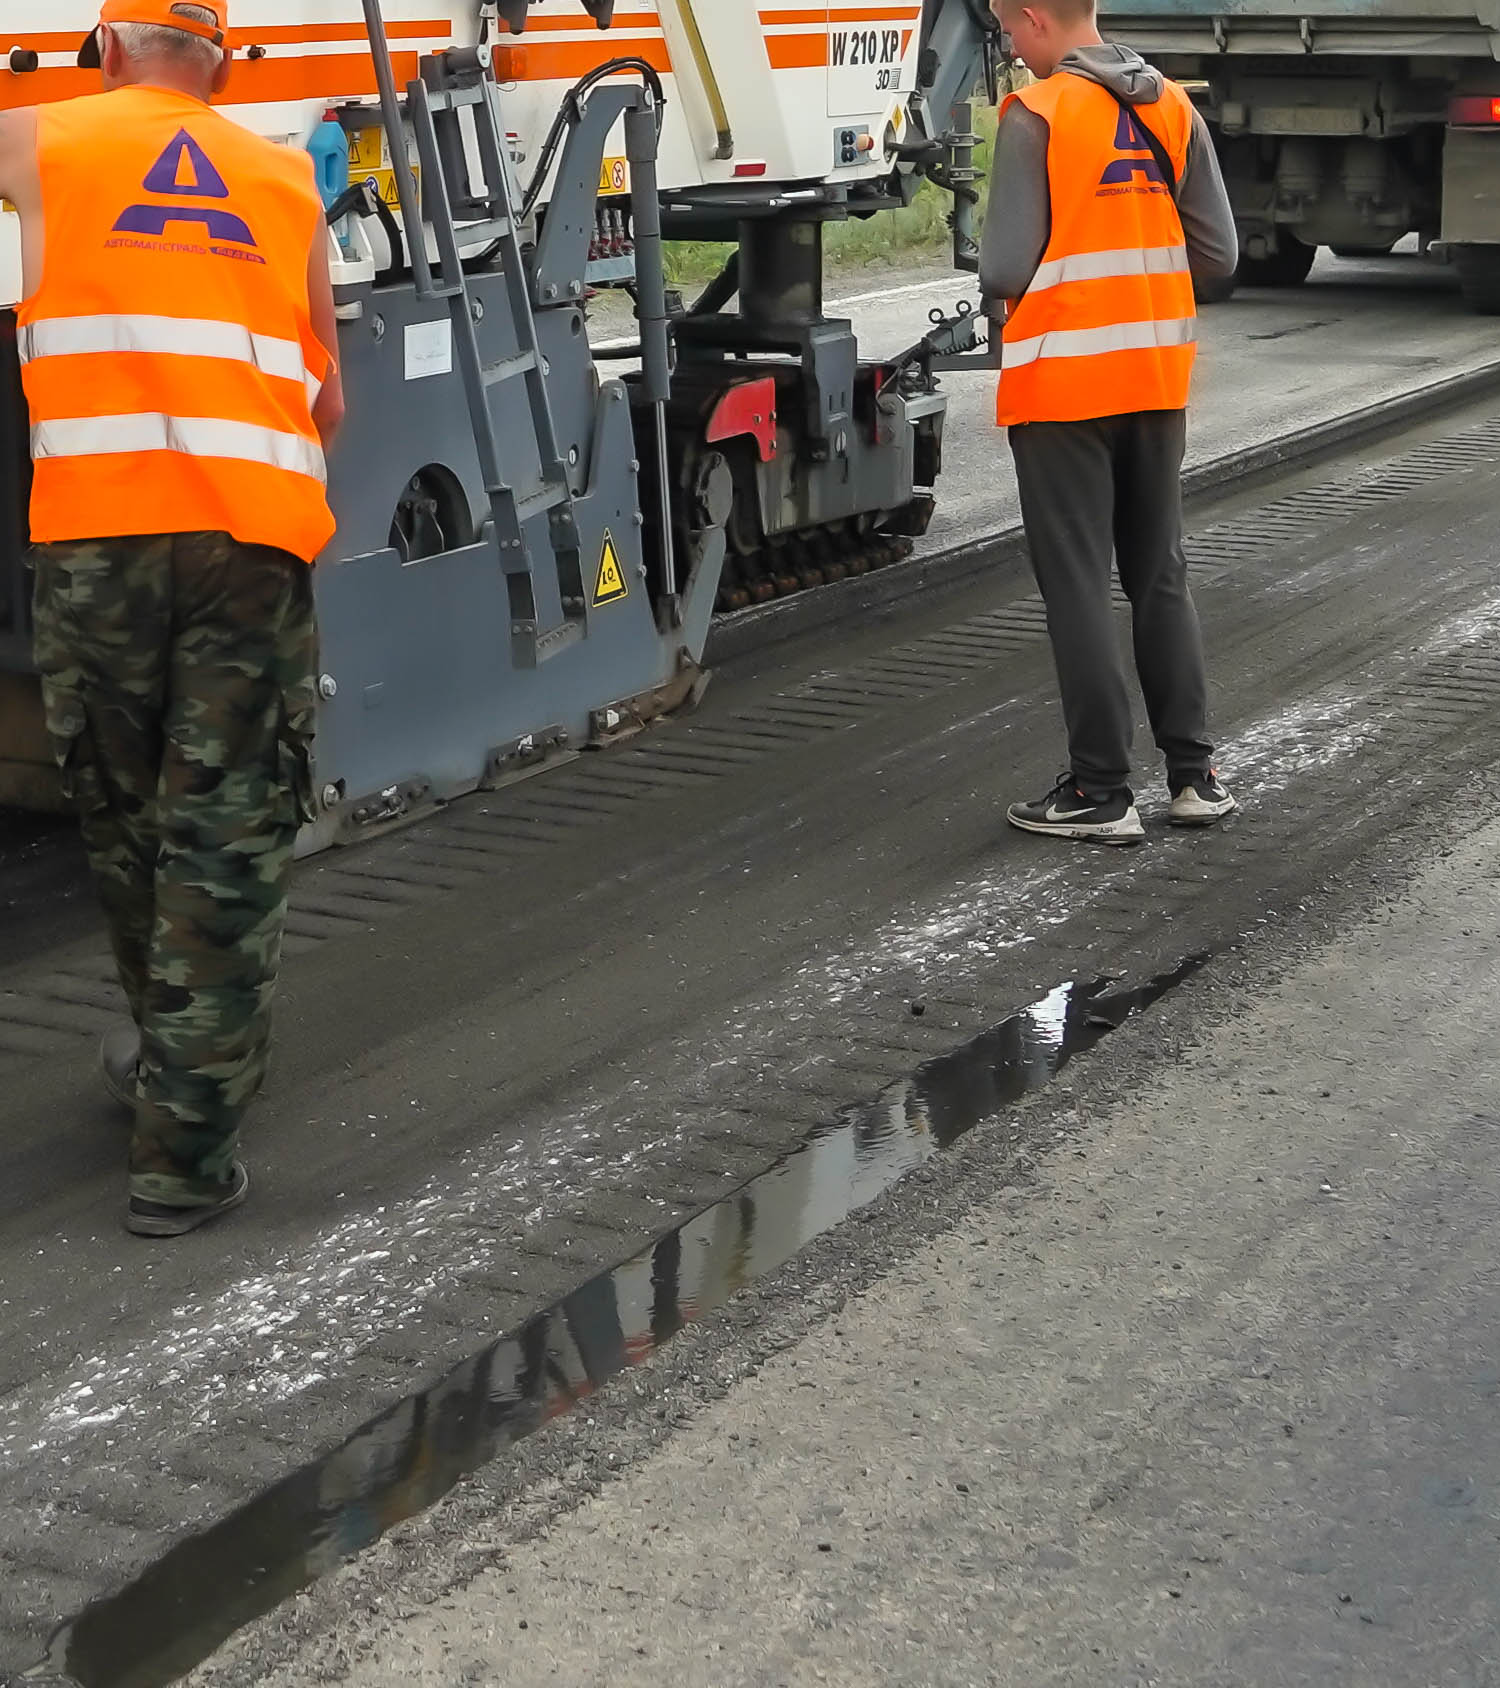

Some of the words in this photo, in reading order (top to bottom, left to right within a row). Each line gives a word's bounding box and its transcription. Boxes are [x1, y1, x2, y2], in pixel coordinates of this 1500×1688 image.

[832, 31, 847, 66] W
[850, 30, 877, 66] 210
[880, 29, 899, 64] XP
